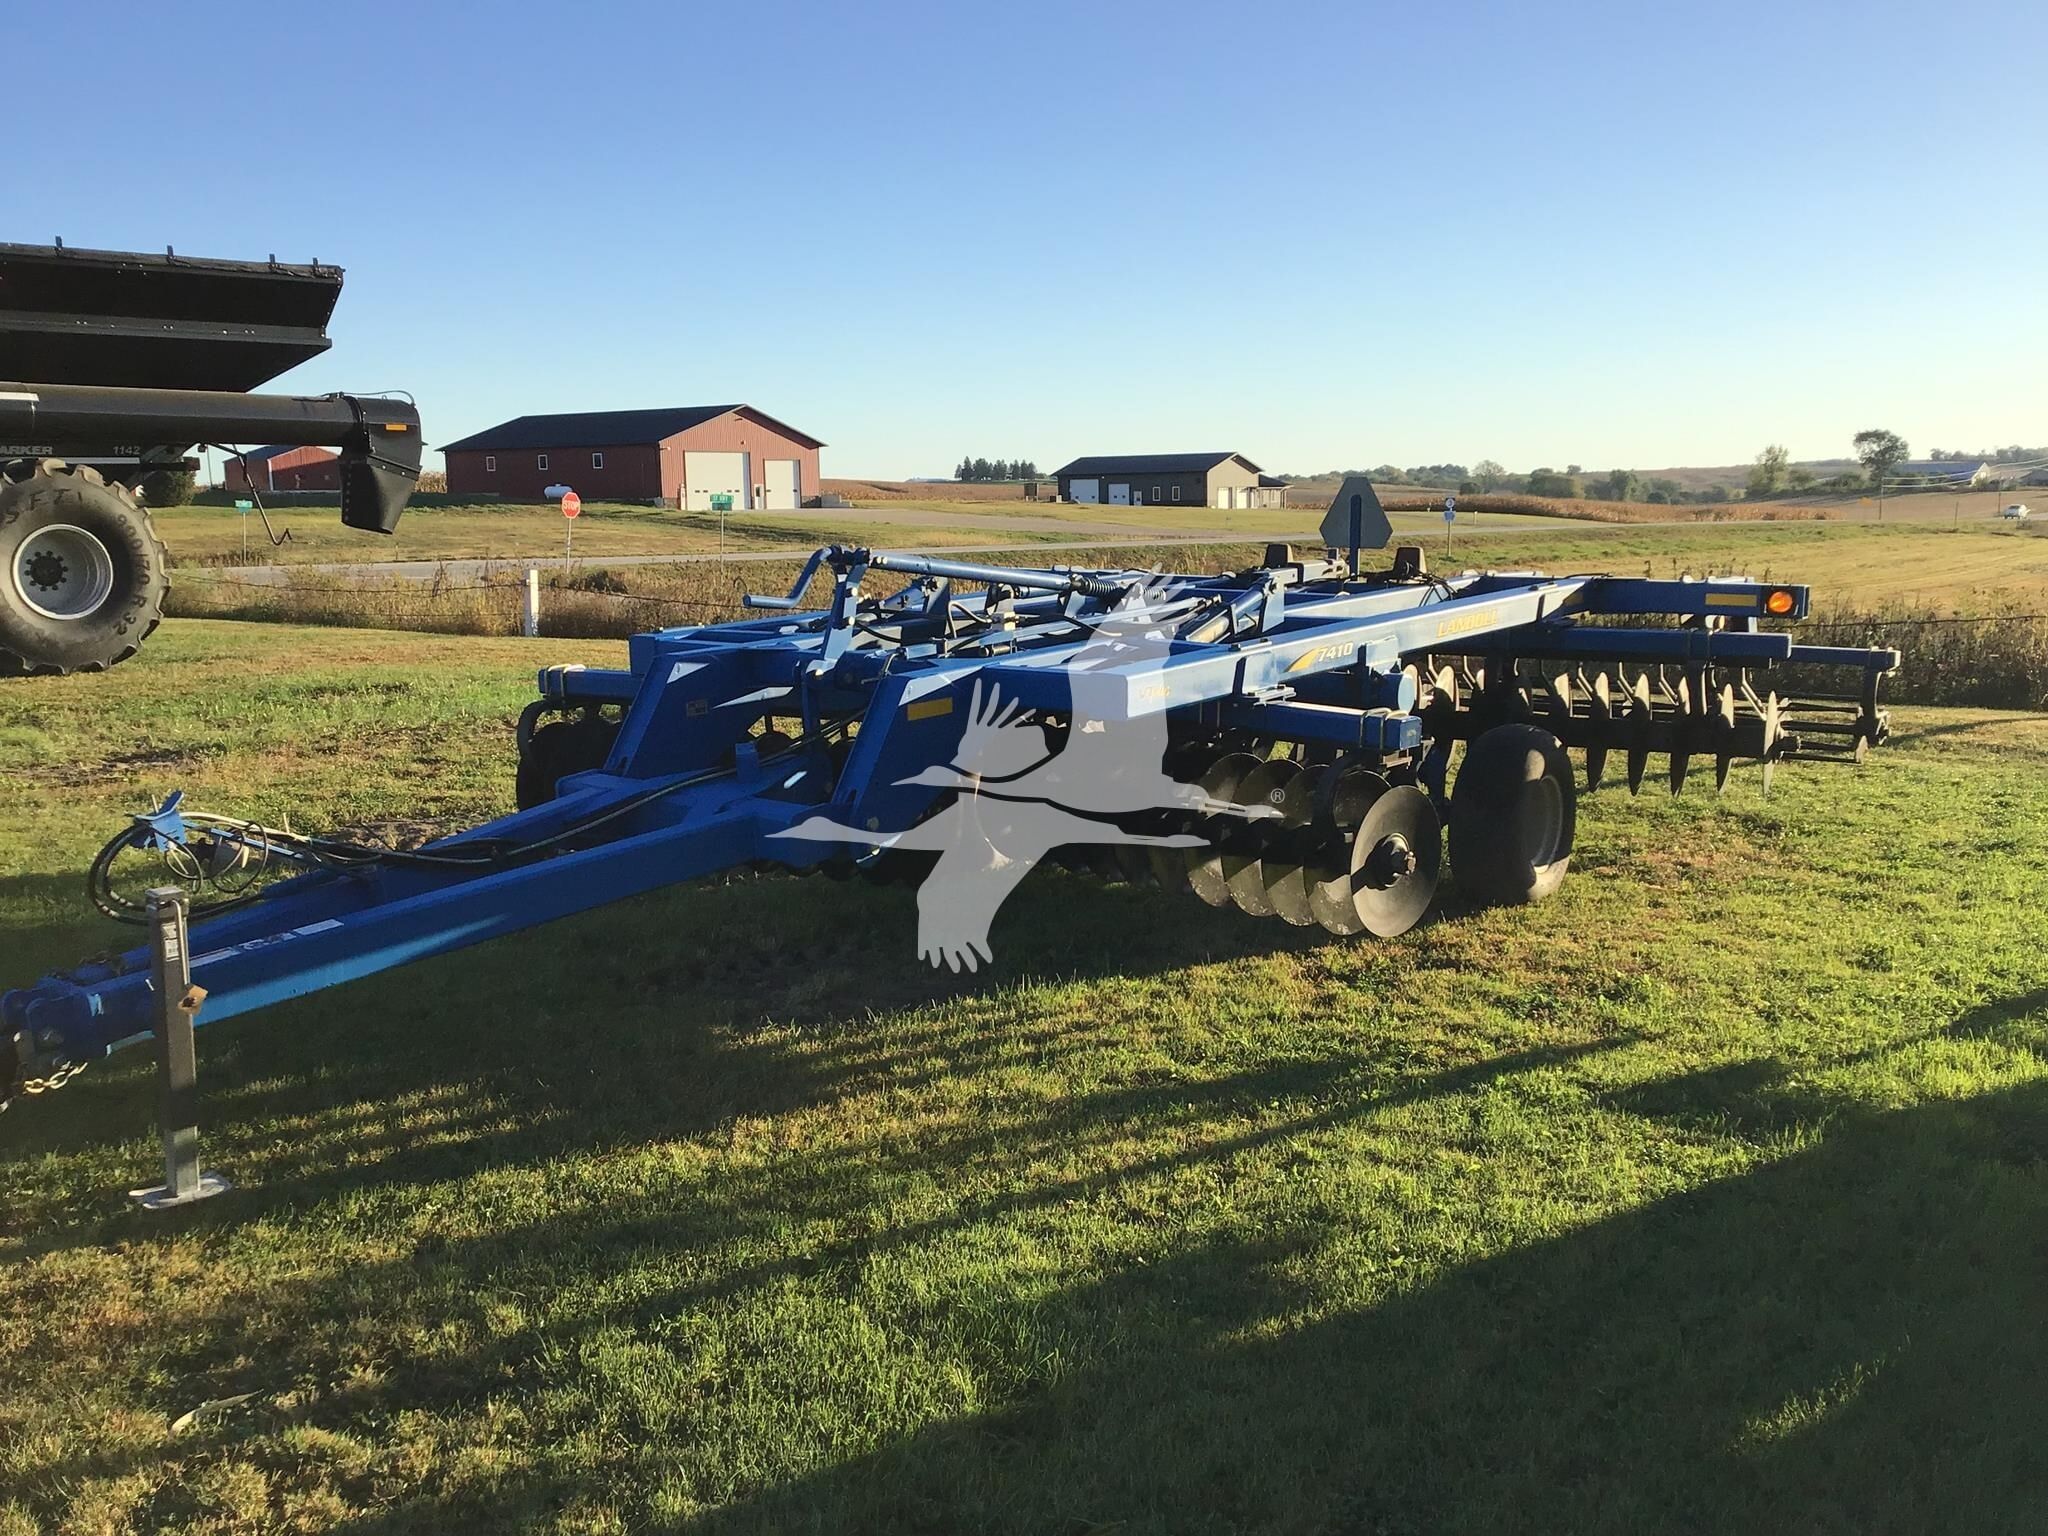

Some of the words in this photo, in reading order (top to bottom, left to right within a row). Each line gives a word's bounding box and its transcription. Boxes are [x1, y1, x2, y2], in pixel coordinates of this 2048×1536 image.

[112, 445, 141, 455] 1142
[563, 500, 580, 511] STOP
[1438, 610, 1497, 637] LANDOLL
[1318, 642, 1354, 662] 7410
